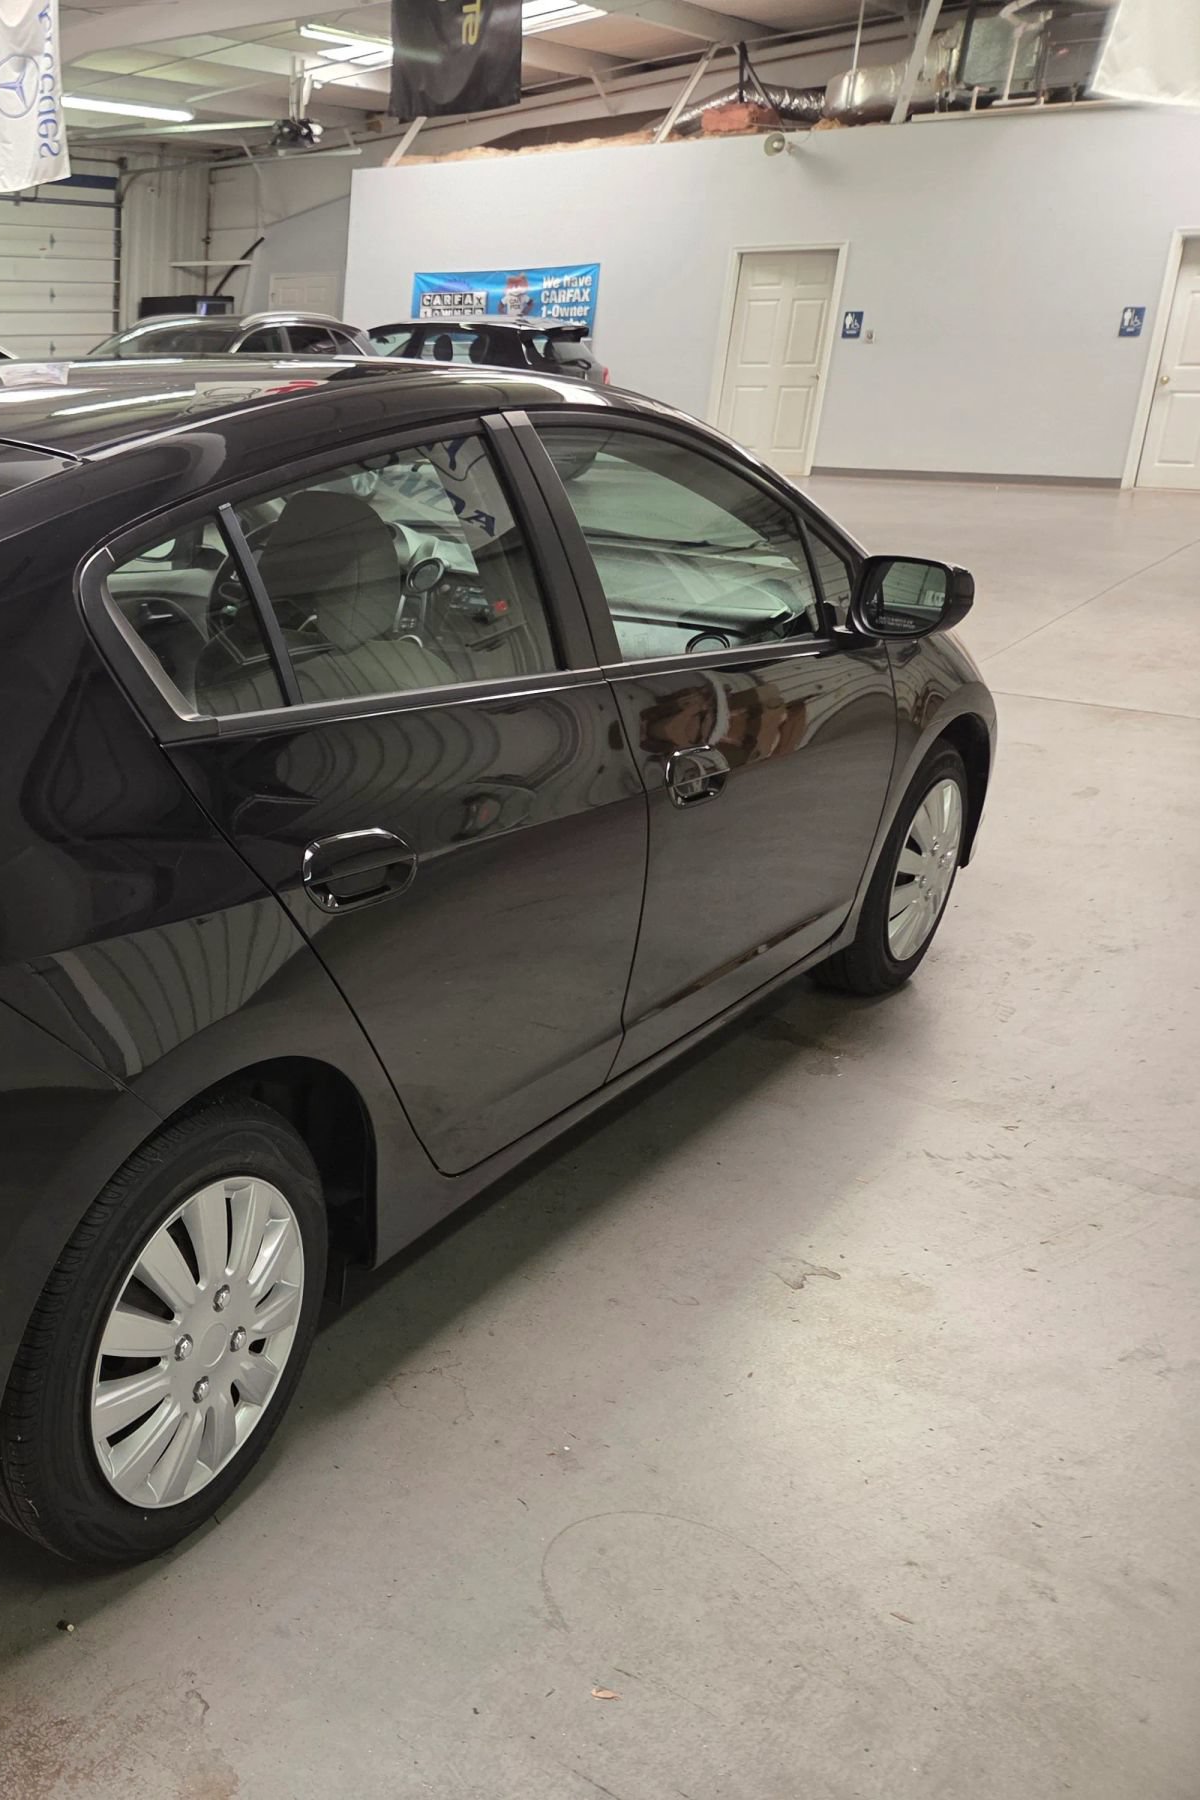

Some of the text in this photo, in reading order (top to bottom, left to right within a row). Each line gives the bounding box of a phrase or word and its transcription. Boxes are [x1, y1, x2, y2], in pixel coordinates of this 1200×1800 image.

[543, 275, 592, 288] We have
[423, 294, 483, 306] CARFAX
[541, 288, 591, 304] CARFAX
[541, 304, 590, 318] 1-Owner
